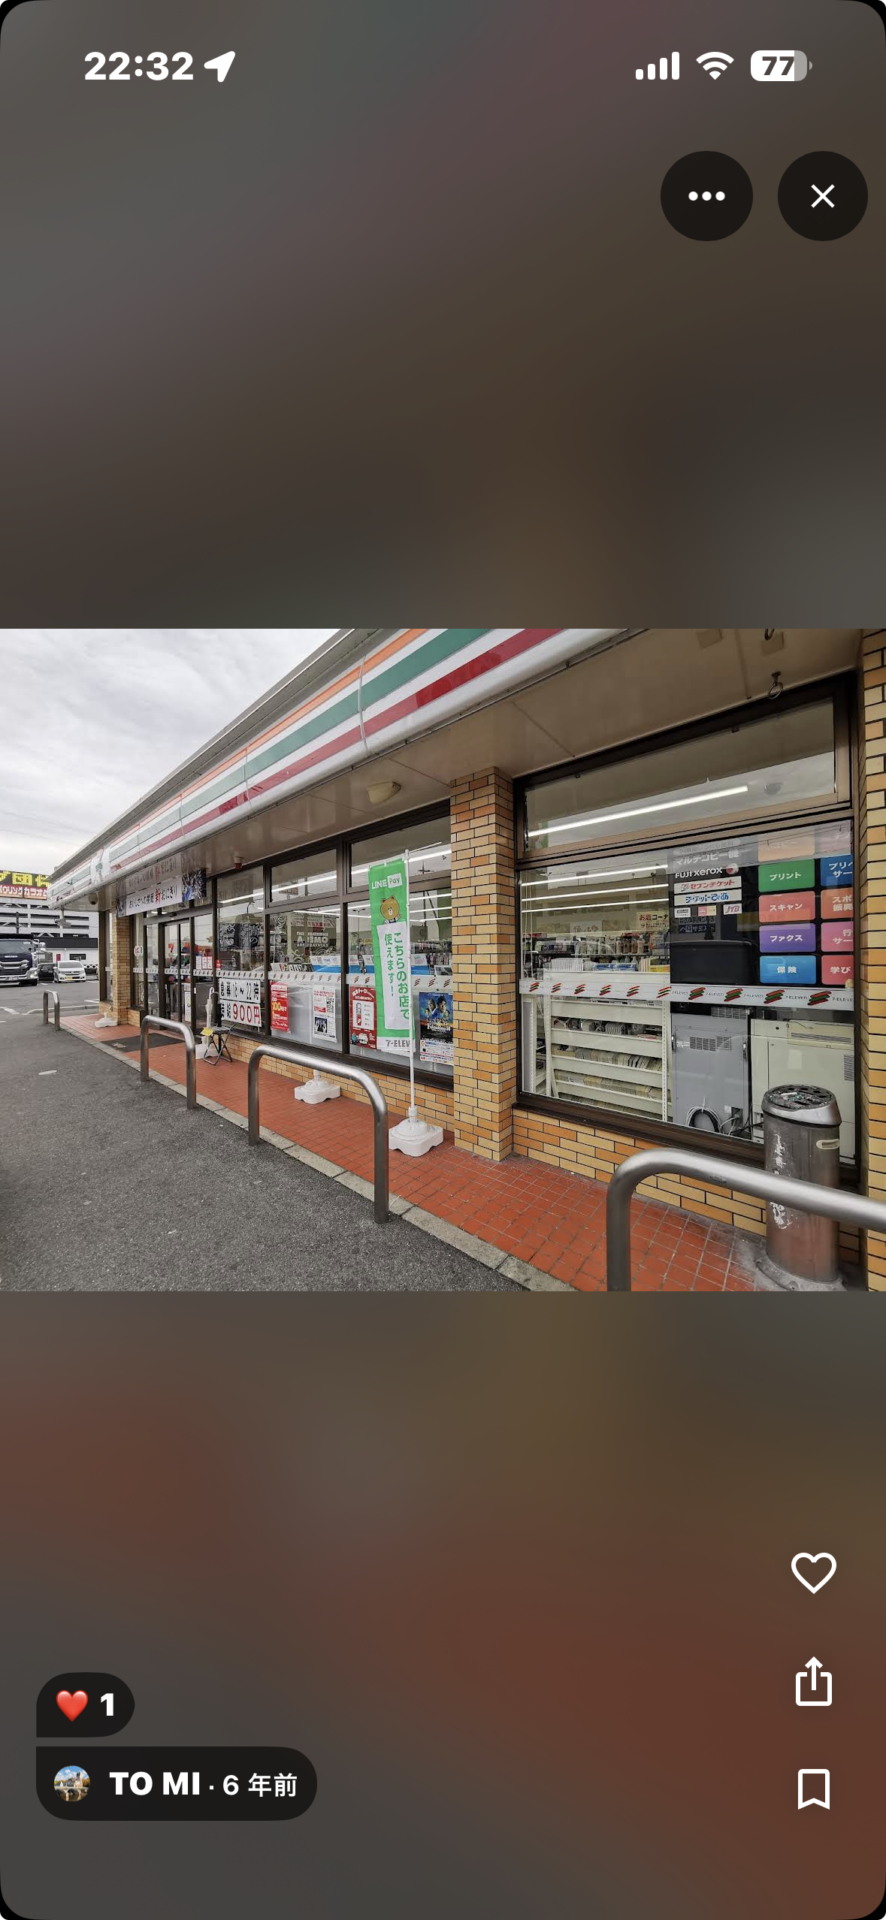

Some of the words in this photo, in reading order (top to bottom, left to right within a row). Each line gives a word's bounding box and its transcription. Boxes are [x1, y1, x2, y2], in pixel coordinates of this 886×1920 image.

[675, 870, 693, 879] FUJI
[769, 871, 802, 881] プリント
[371, 879, 388, 889] LINE
[690, 879, 735, 890] セブンチケット
[725, 905, 740, 914] JTB
[769, 903, 803, 912] スキャン
[769, 934, 803, 943] ファクス
[776, 965, 797, 974] 保険
[829, 966, 851, 974] 学び
[393, 932, 410, 1020] こちらのお店で
